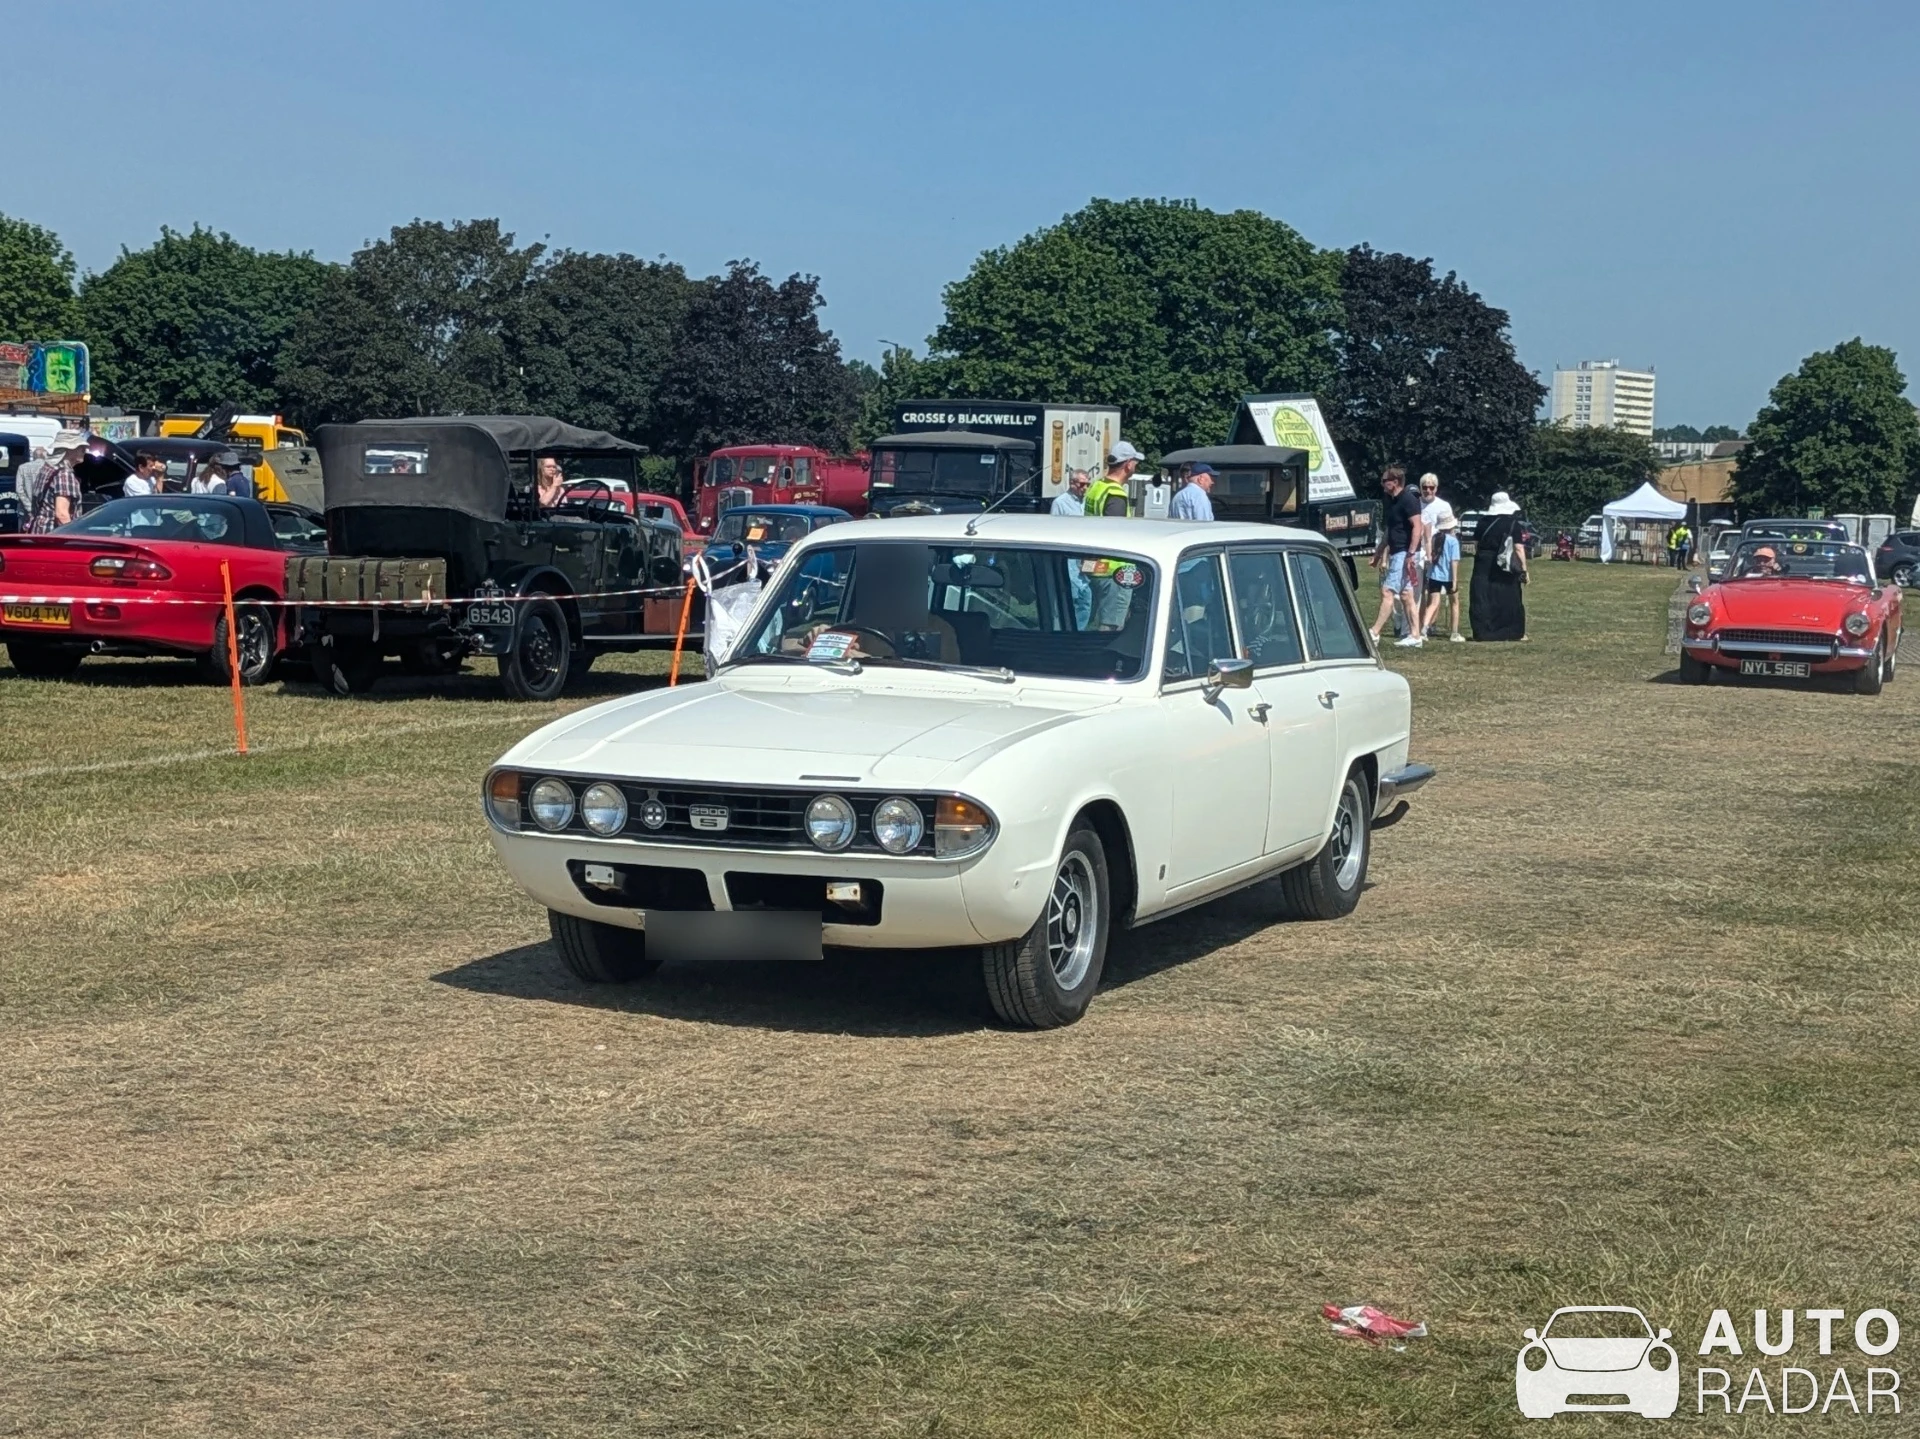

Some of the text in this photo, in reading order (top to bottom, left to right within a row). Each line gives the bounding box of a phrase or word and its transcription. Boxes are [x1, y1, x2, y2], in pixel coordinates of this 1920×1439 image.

[902, 412, 946, 423] CROSSE
[947, 413, 956, 423] &
[957, 413, 1023, 425] BLACKWELL
[1065, 422, 1102, 444] FAMOUS
[1278, 432, 1318, 448] MUSEUM
[6, 605, 70, 621] V604 TVV
[470, 608, 512, 624] 6543
[1744, 661, 1806, 676] NYL 561E
[691, 806, 728, 816] 2500
[699, 817, 718, 828] S
